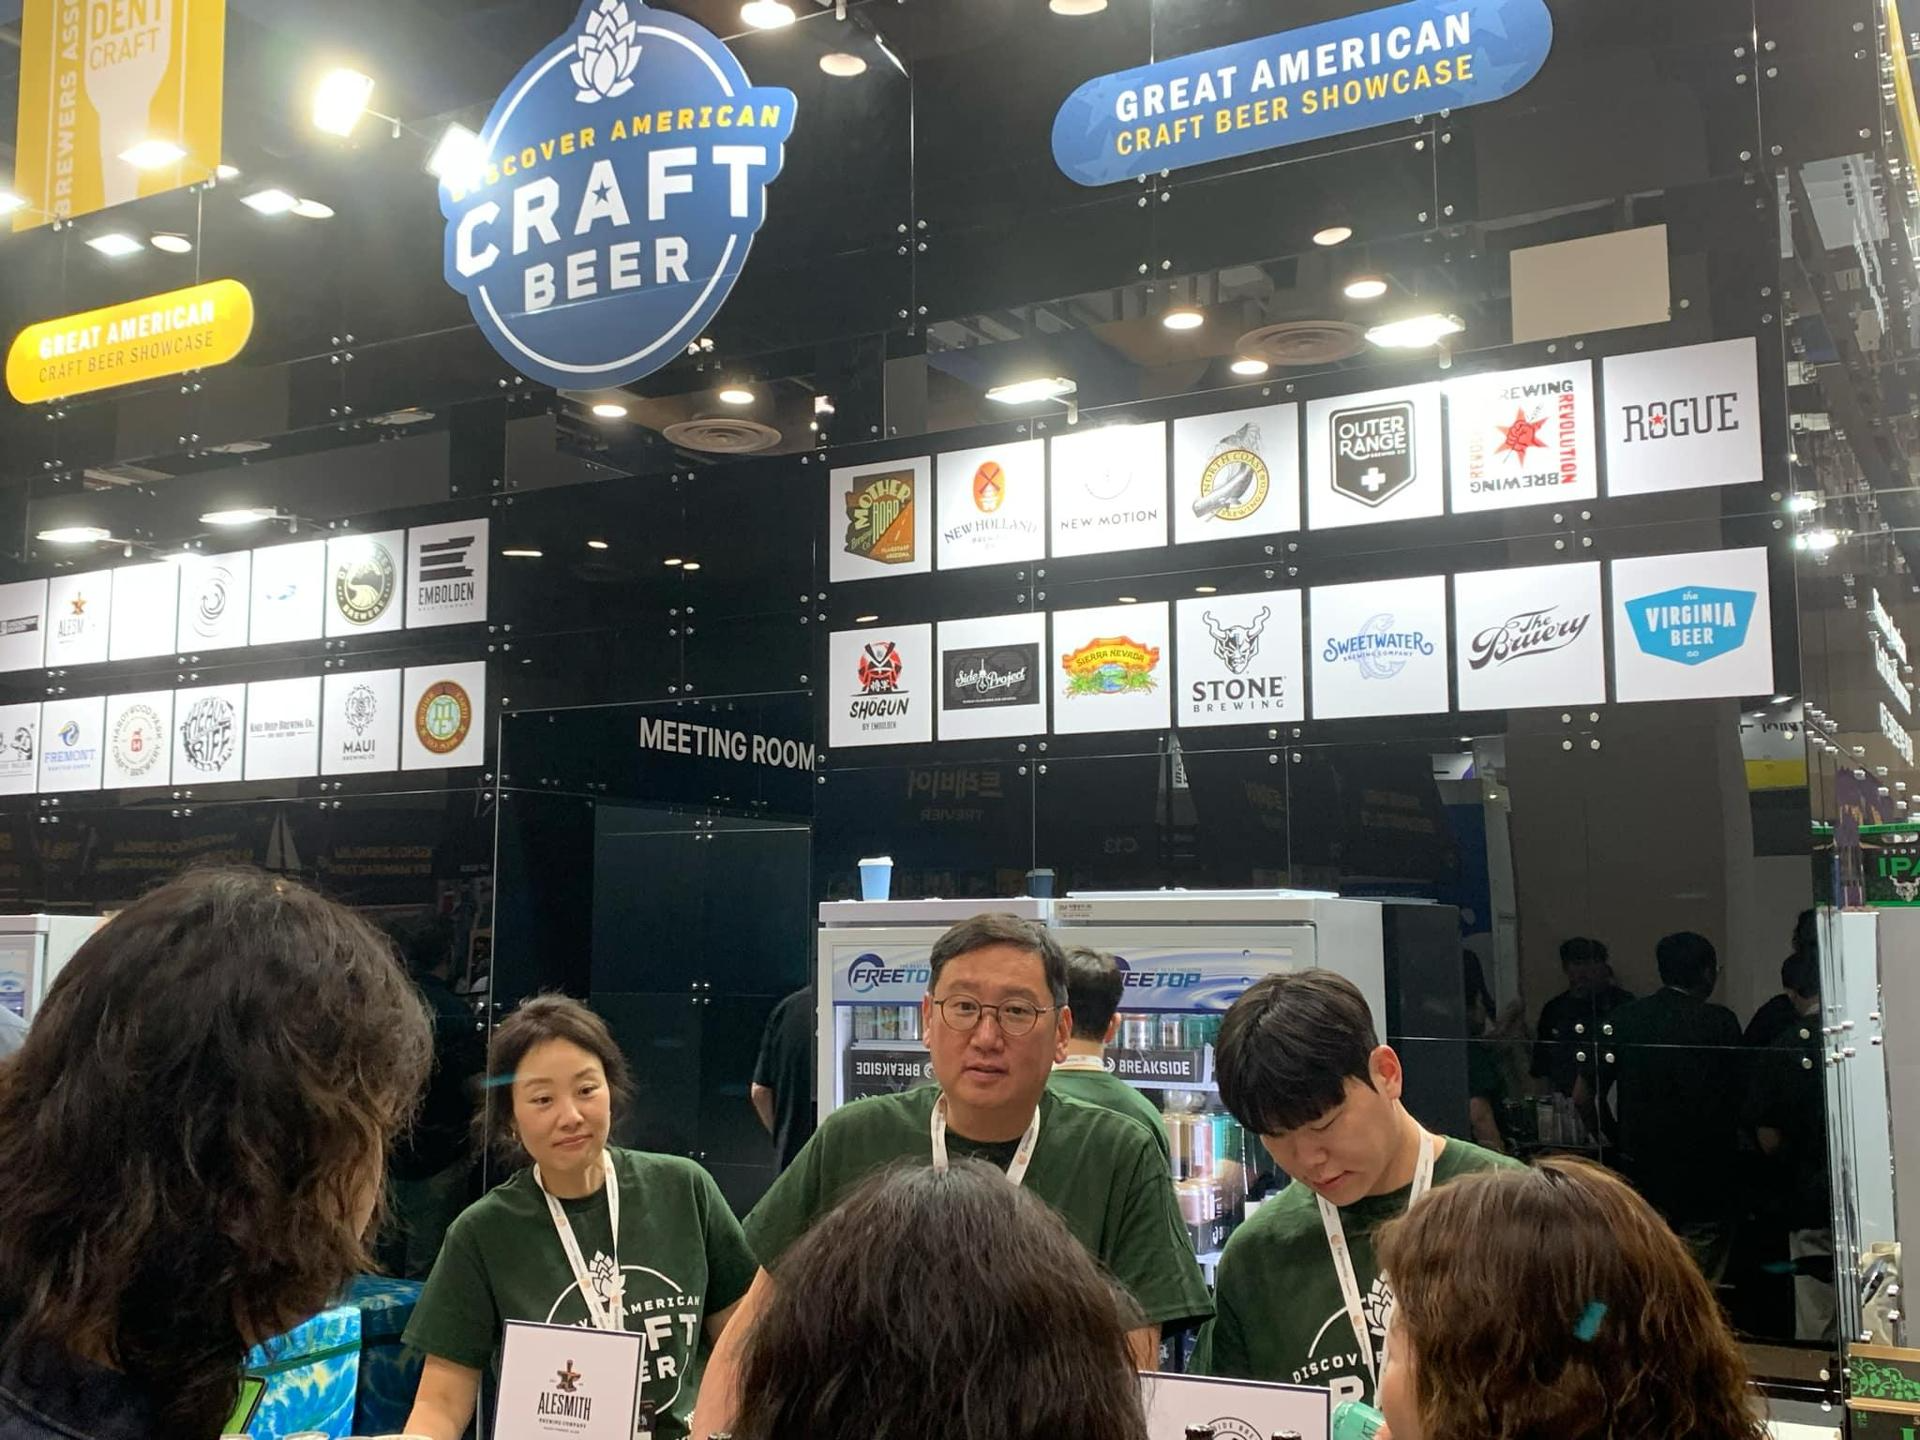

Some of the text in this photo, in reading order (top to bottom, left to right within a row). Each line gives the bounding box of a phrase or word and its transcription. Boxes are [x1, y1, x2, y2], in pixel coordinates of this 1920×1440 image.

[89, 27, 161, 71] CRAFT
[1115, 11, 1472, 122] GREAT AMERICAN
[1116, 55, 1474, 156] CRAFT BEER SHOWCASE
[610, 105, 782, 141] AMERICAN
[55, 74, 79, 218] BREWERS
[456, 145, 767, 278] CRAFT
[524, 236, 690, 313] BEER
[39, 300, 215, 361] GREAT AMERICAN
[38, 330, 215, 384] CRAFT BEER SHOWCASE
[1498, 379, 1575, 400] REWING
[1339, 415, 1405, 439] OUTER
[1621, 392, 1740, 443] ROGUE
[1340, 432, 1407, 460] RANGE
[1558, 393, 1578, 485] REVOLUTION
[1203, 452, 1265, 493] NORTH COAST
[1470, 471, 1560, 494] BREWING
[854, 479, 911, 531] MOTHER
[872, 499, 900, 545] ROAD
[944, 517, 1038, 544] NEW HOLLAND
[1060, 509, 1158, 531] NEW MOTION
[418, 581, 475, 606] EMBOLDEN
[1508, 605, 1556, 634] The
[1645, 602, 1737, 632] VIRGINIA
[1323, 632, 1434, 662] SWEETWATER
[1670, 627, 1715, 646] BEER
[1076, 649, 1145, 667] SIERRA NEVADA
[955, 666, 1028, 690] Side Project
[1192, 675, 1284, 702] STONE
[849, 698, 910, 721] SHOGUN
[1193, 700, 1285, 713] BREWING
[44, 748, 97, 763] FREMONT
[342, 740, 376, 754] MAUI
[639, 716, 815, 771] MEETING ROOM
[853, 968, 930, 987] FREETO
[1120, 972, 1201, 987] EETOP
[856, 1061, 921, 1077] BREAKSIDE
[1118, 1059, 1191, 1075] BREAKSIDE
[537, 1391, 592, 1421] ALESMITH
